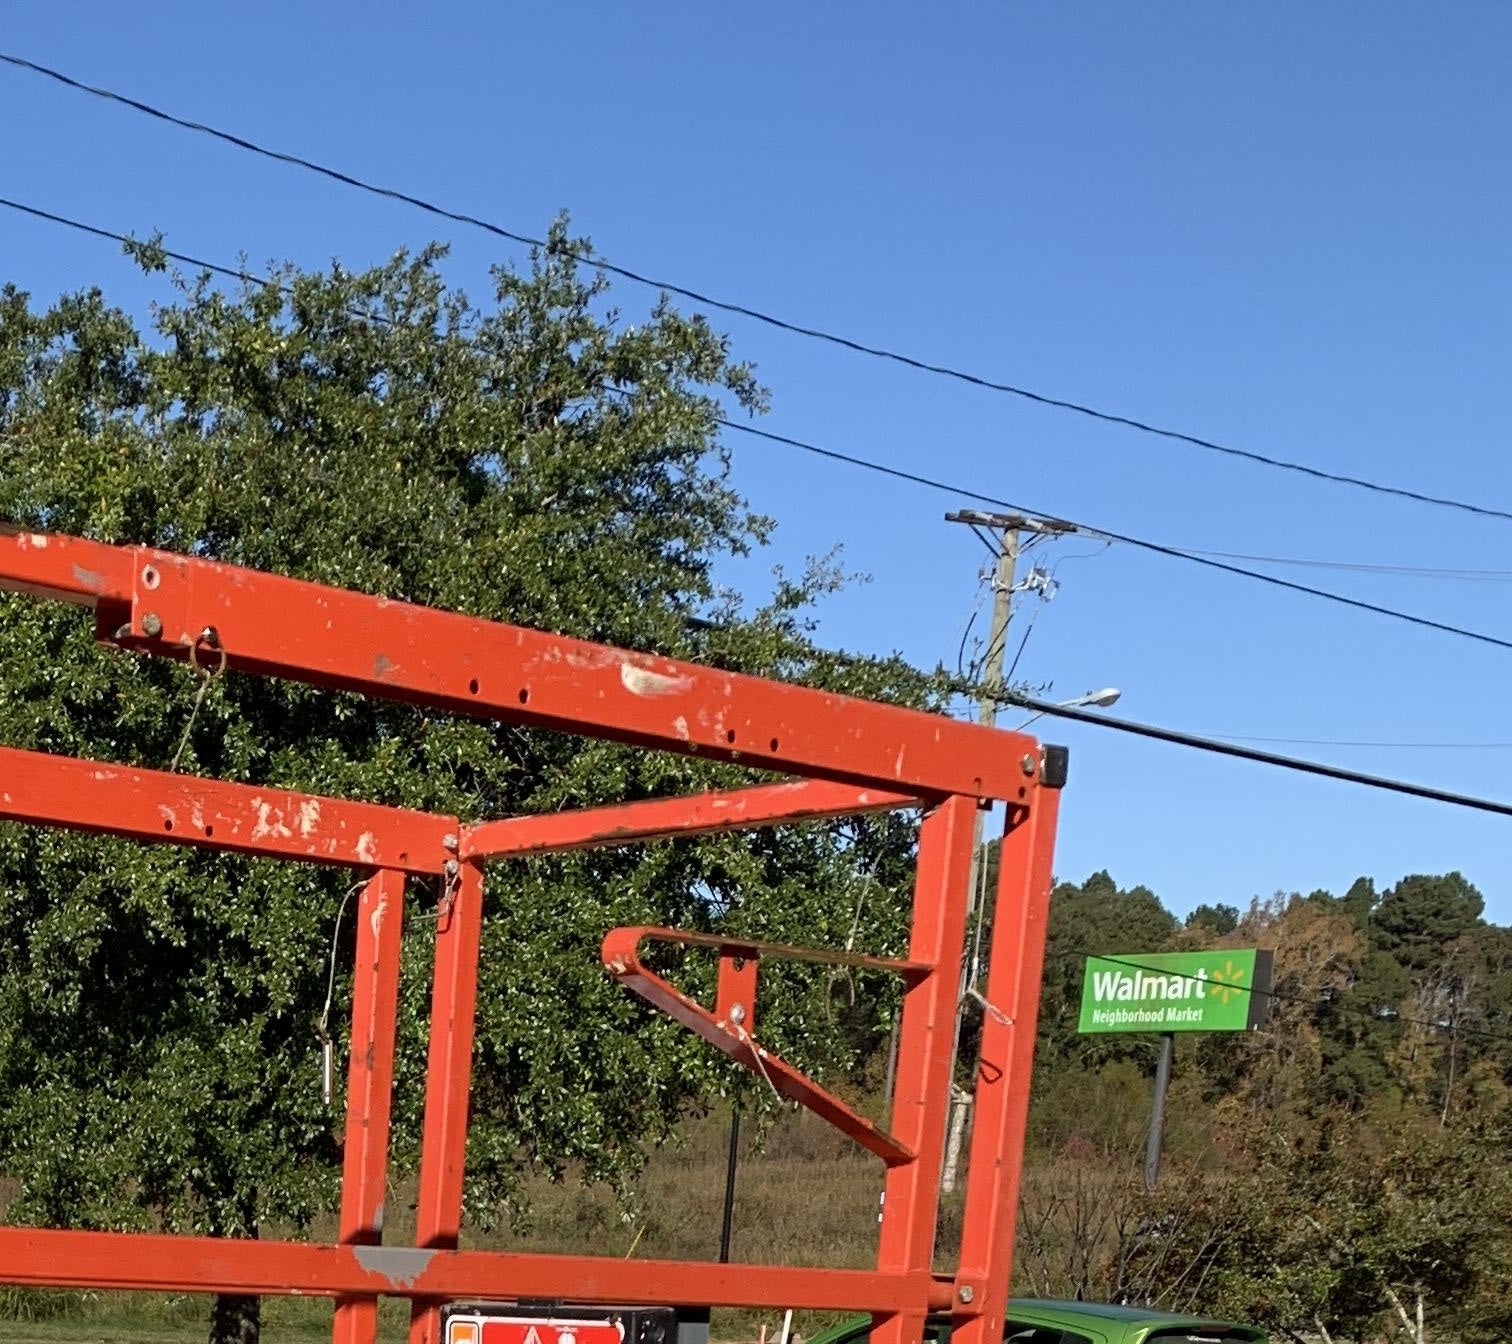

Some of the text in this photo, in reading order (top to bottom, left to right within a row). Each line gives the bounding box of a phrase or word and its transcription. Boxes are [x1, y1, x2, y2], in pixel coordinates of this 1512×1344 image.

[1092, 967, 1208, 1002] Walmart
[1092, 1006, 1204, 1027] Neighborhood Market
